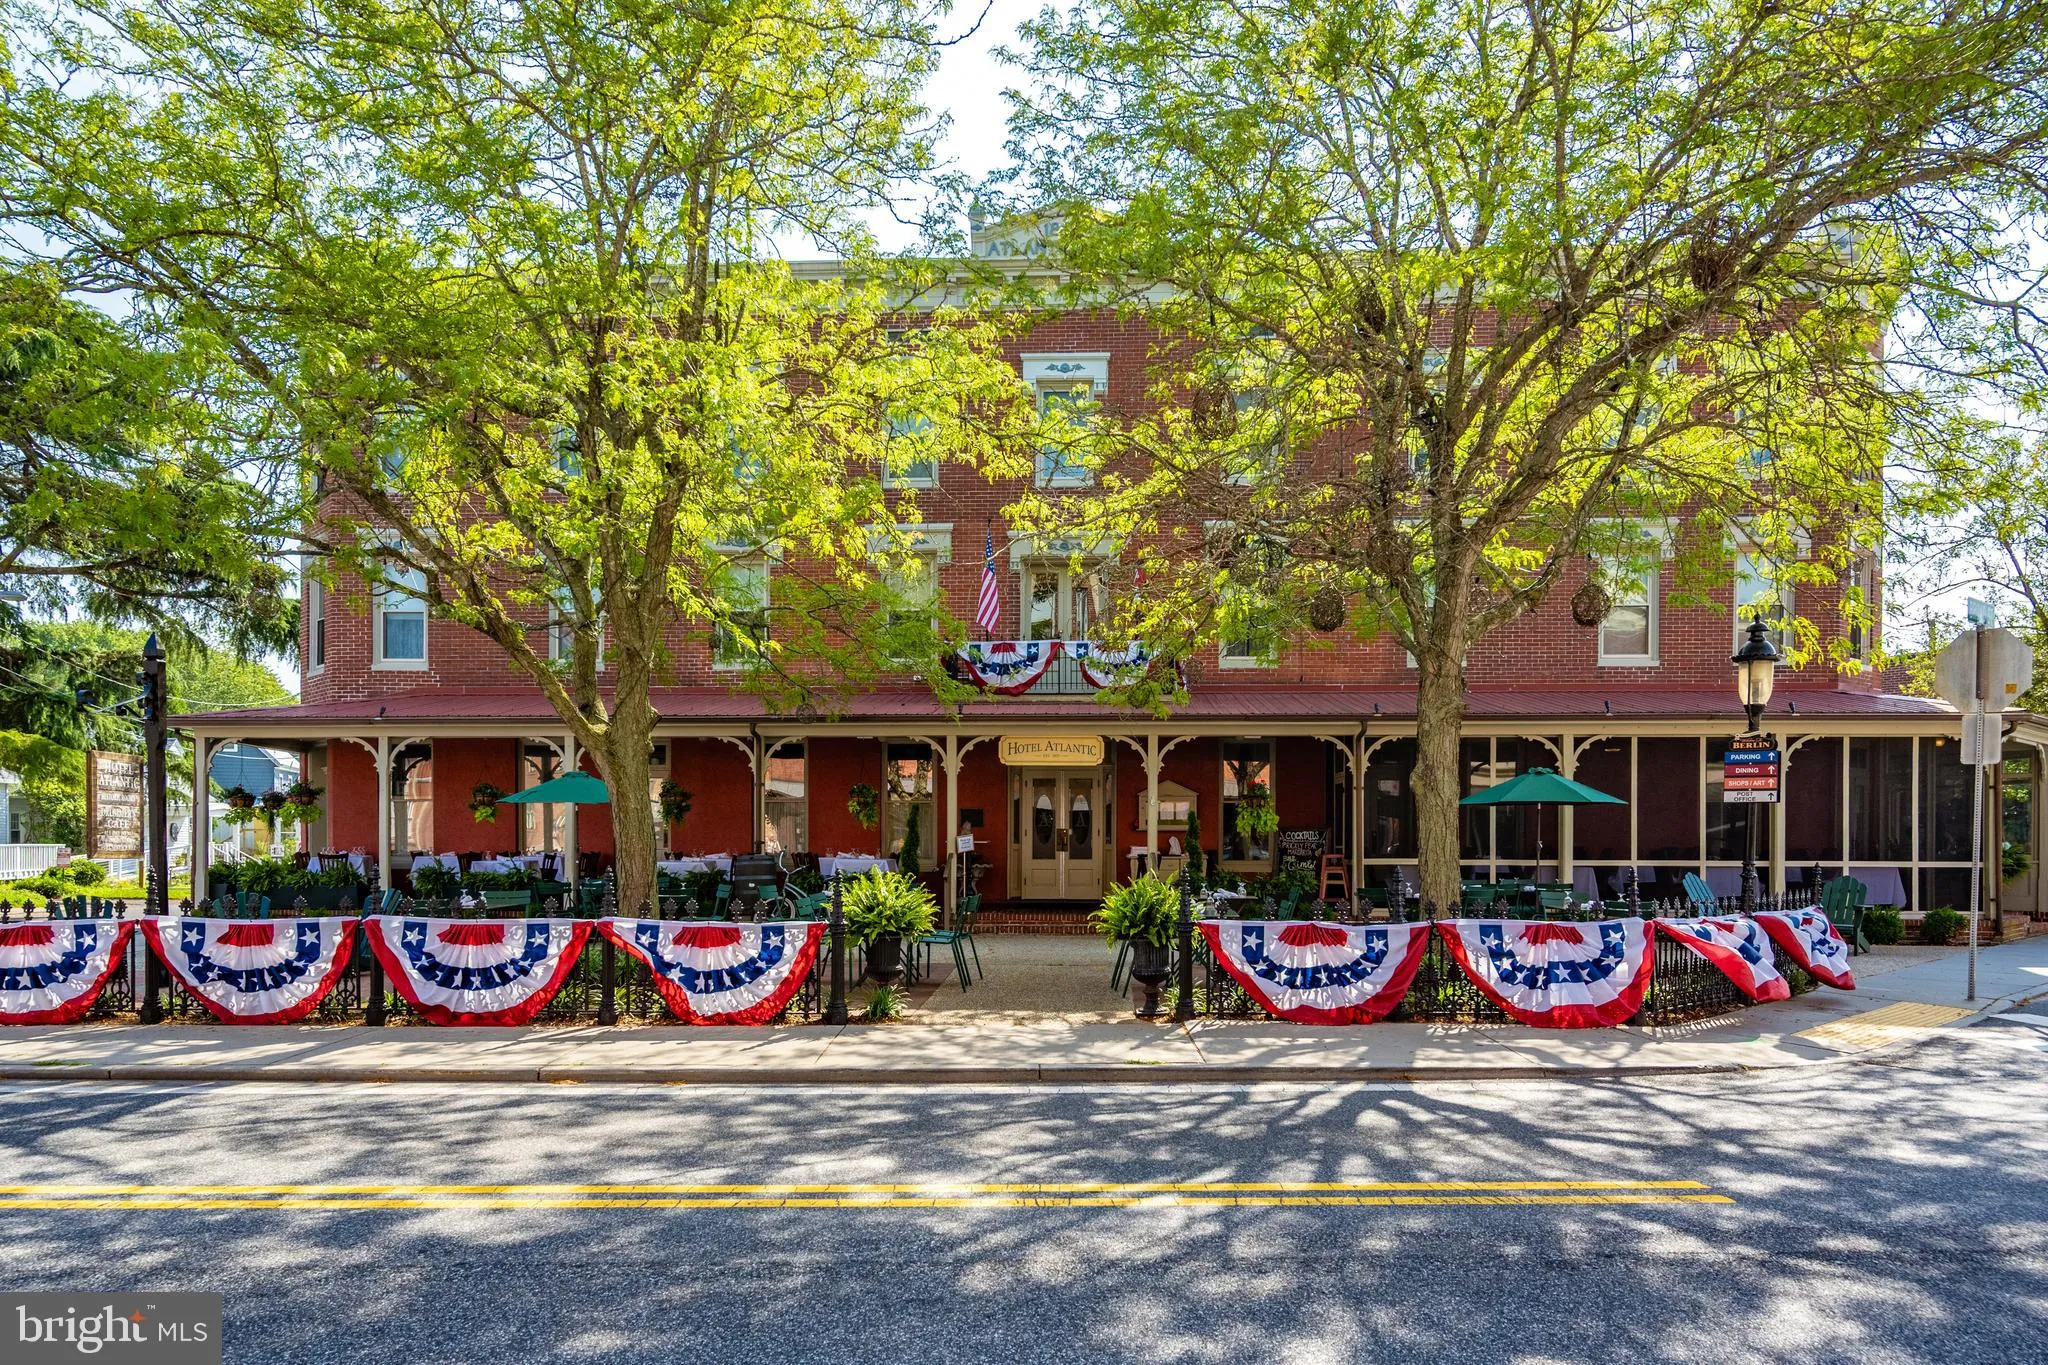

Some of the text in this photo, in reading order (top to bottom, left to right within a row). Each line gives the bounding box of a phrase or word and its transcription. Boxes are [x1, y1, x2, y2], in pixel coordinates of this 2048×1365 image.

[1732, 741, 1770, 749] BERLIN
[104, 761, 133, 775] HOTEL
[99, 774, 141, 789] ATLANTIC
[1285, 831, 1319, 840] COCKTAILS
